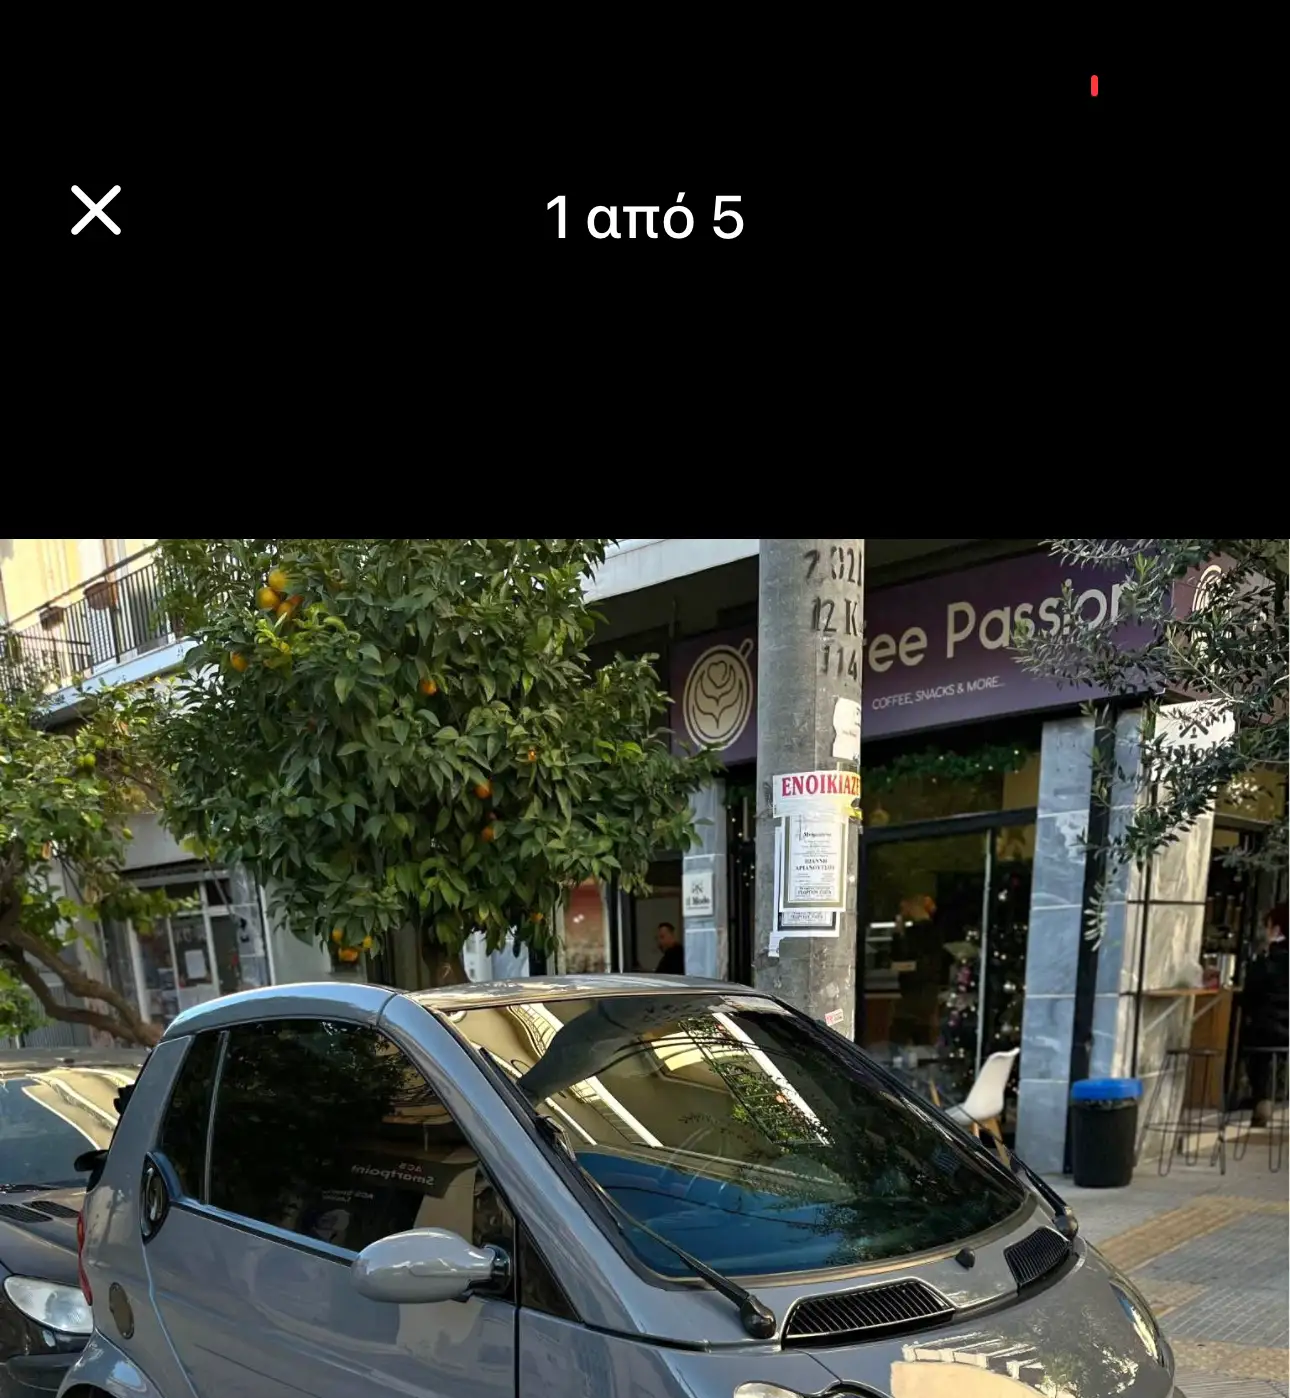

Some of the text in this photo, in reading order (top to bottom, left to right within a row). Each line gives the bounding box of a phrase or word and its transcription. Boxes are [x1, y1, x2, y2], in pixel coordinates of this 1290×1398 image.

[863, 620, 927, 672] ee
[872, 692, 914, 710] COFFEE,
[915, 684, 955, 702] SNACKS
[957, 682, 964, 694] &
